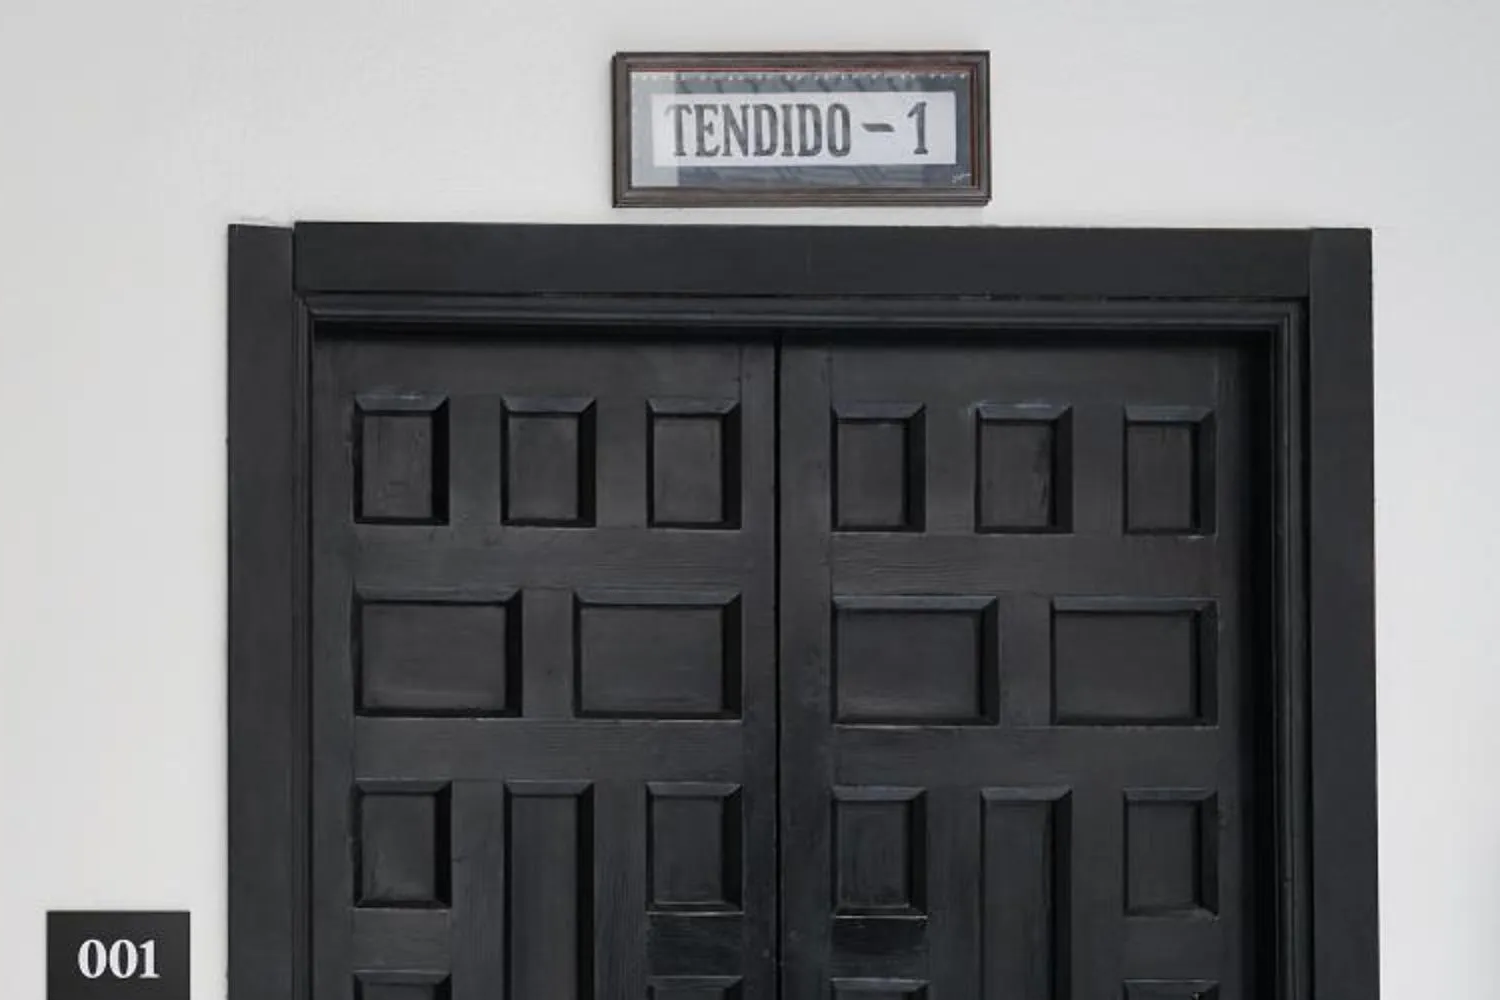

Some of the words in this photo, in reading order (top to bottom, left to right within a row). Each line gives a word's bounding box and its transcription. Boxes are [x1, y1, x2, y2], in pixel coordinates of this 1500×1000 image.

[665, 101, 851, 158] TENDIDO
[906, 100, 929, 155] 1
[77, 939, 160, 979] 001
